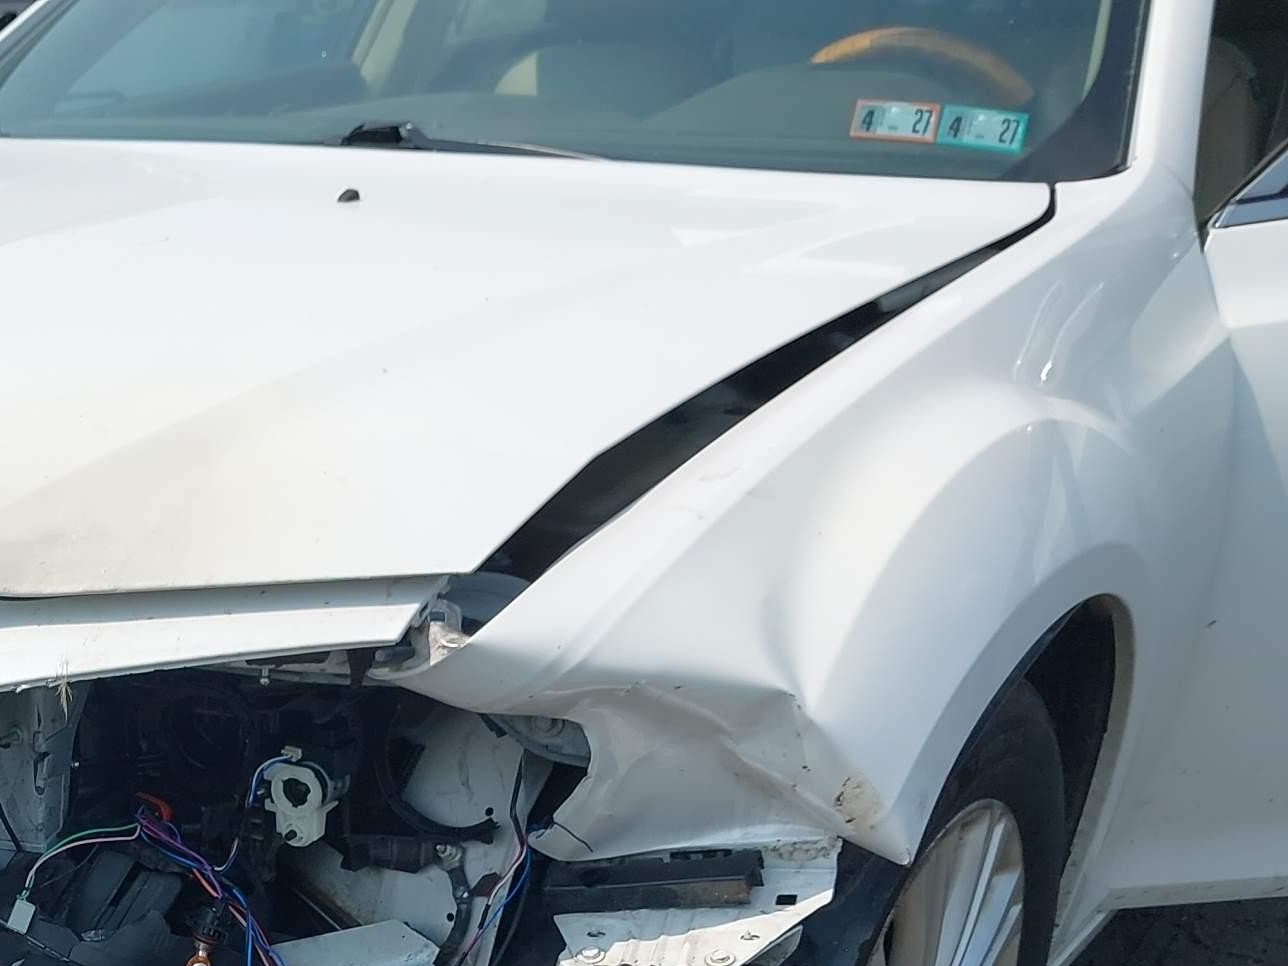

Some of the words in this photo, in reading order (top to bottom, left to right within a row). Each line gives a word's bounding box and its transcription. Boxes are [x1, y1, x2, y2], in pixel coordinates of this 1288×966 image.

[861, 109, 875, 132] 4
[912, 109, 933, 136] 27
[948, 116, 963, 139] 4
[998, 118, 1020, 145] 27
